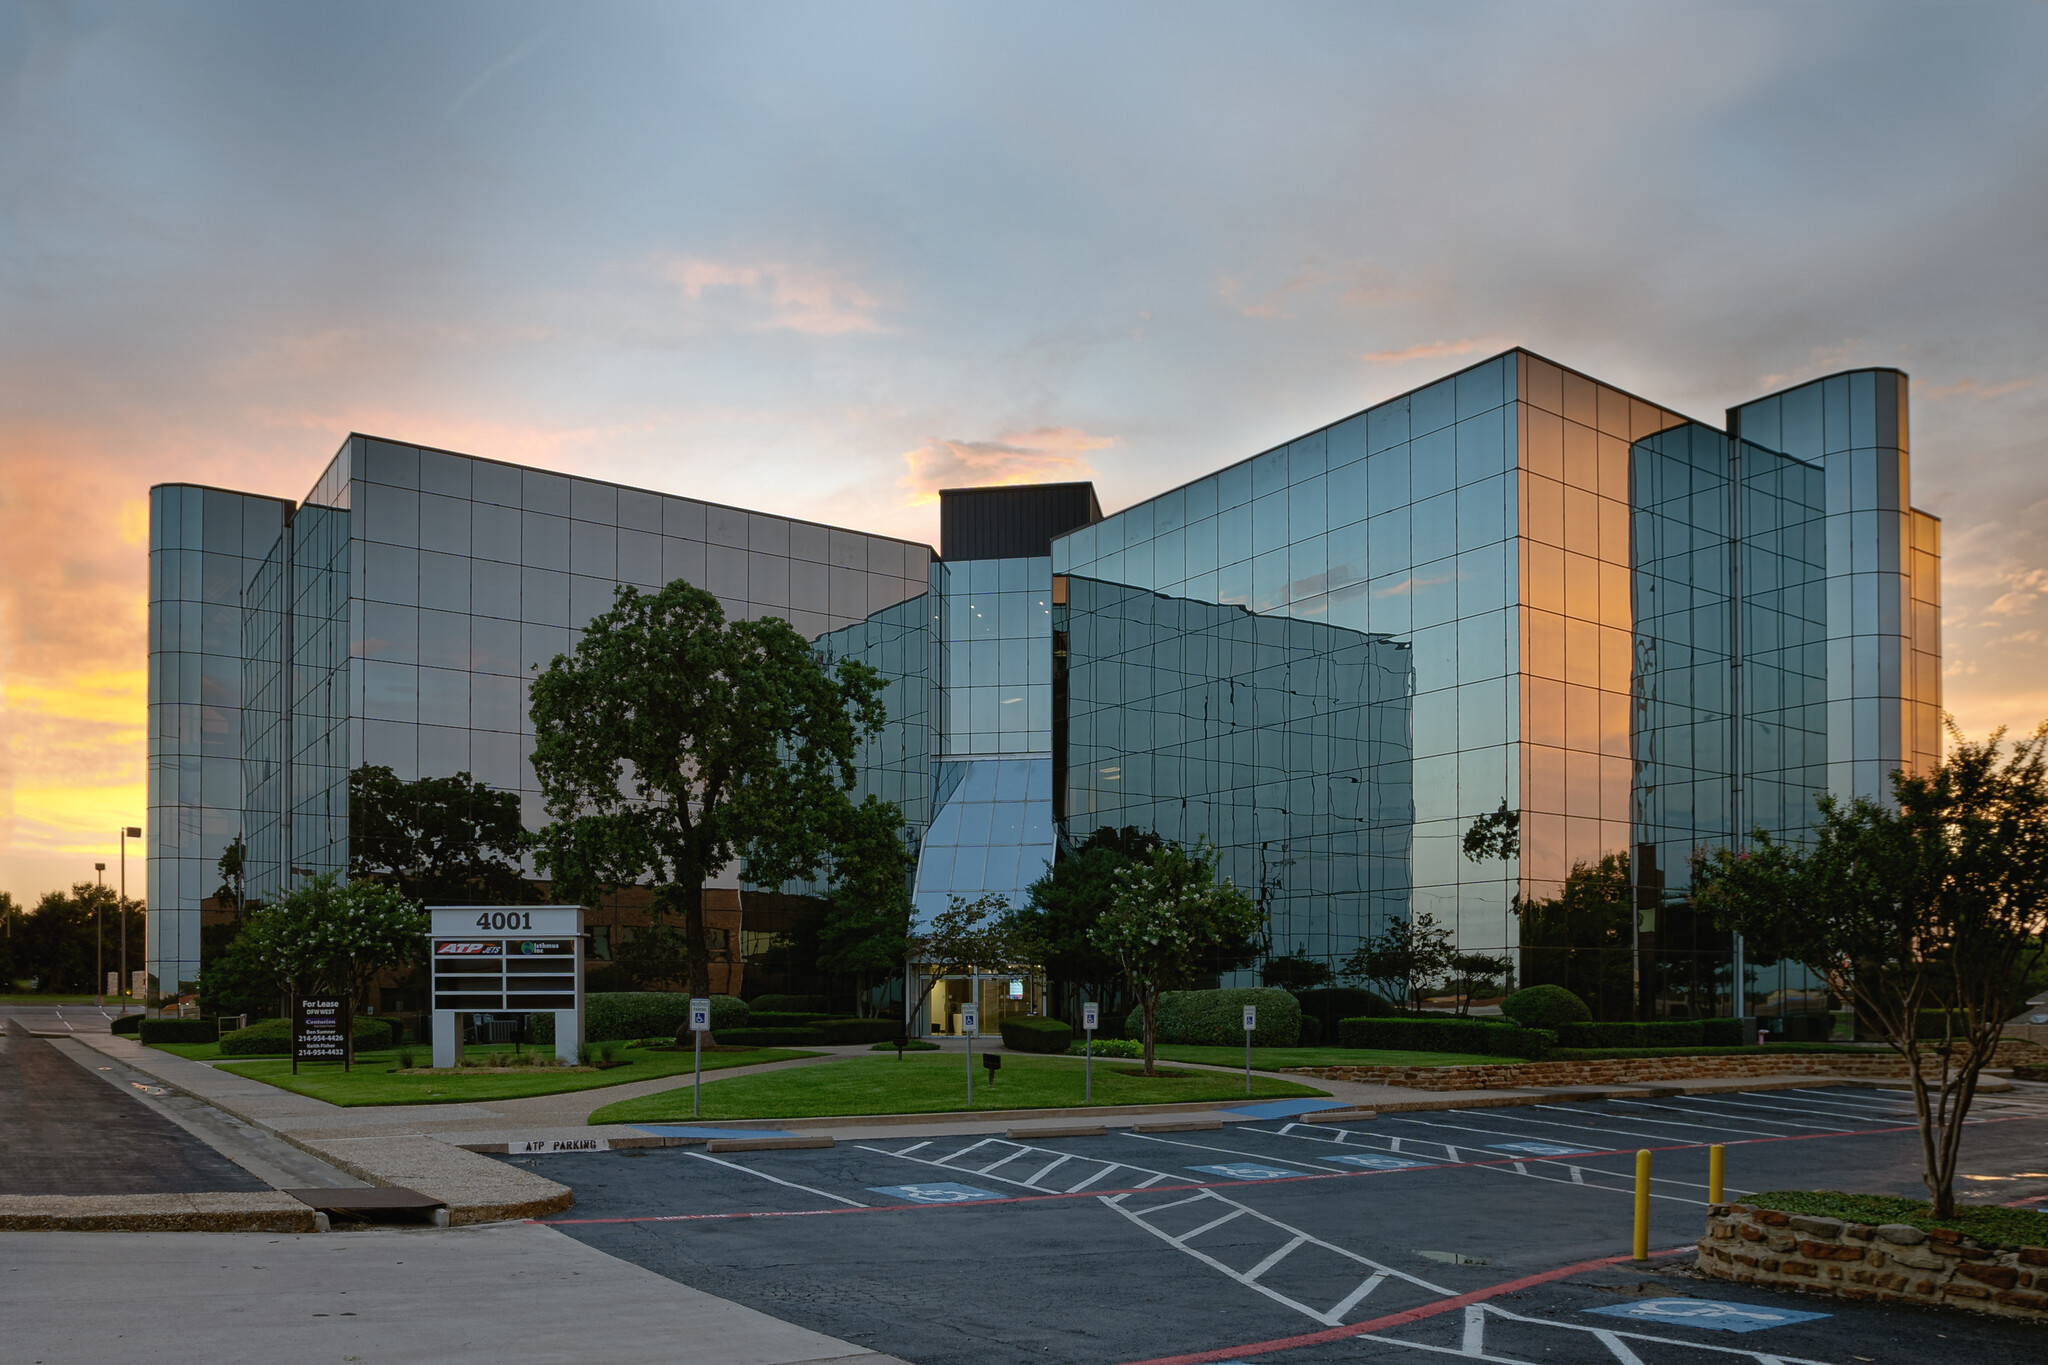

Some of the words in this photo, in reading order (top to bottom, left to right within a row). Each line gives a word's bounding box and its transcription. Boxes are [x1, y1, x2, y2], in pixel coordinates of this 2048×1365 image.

[476, 912, 532, 930] 4001
[437, 943, 483, 954] ATP
[482, 946, 501, 954] JETS
[302, 1000, 316, 1008] For
[317, 1000, 340, 1008] Lease
[525, 1141, 545, 1151] ATP
[553, 1139, 597, 1151] PARKING
